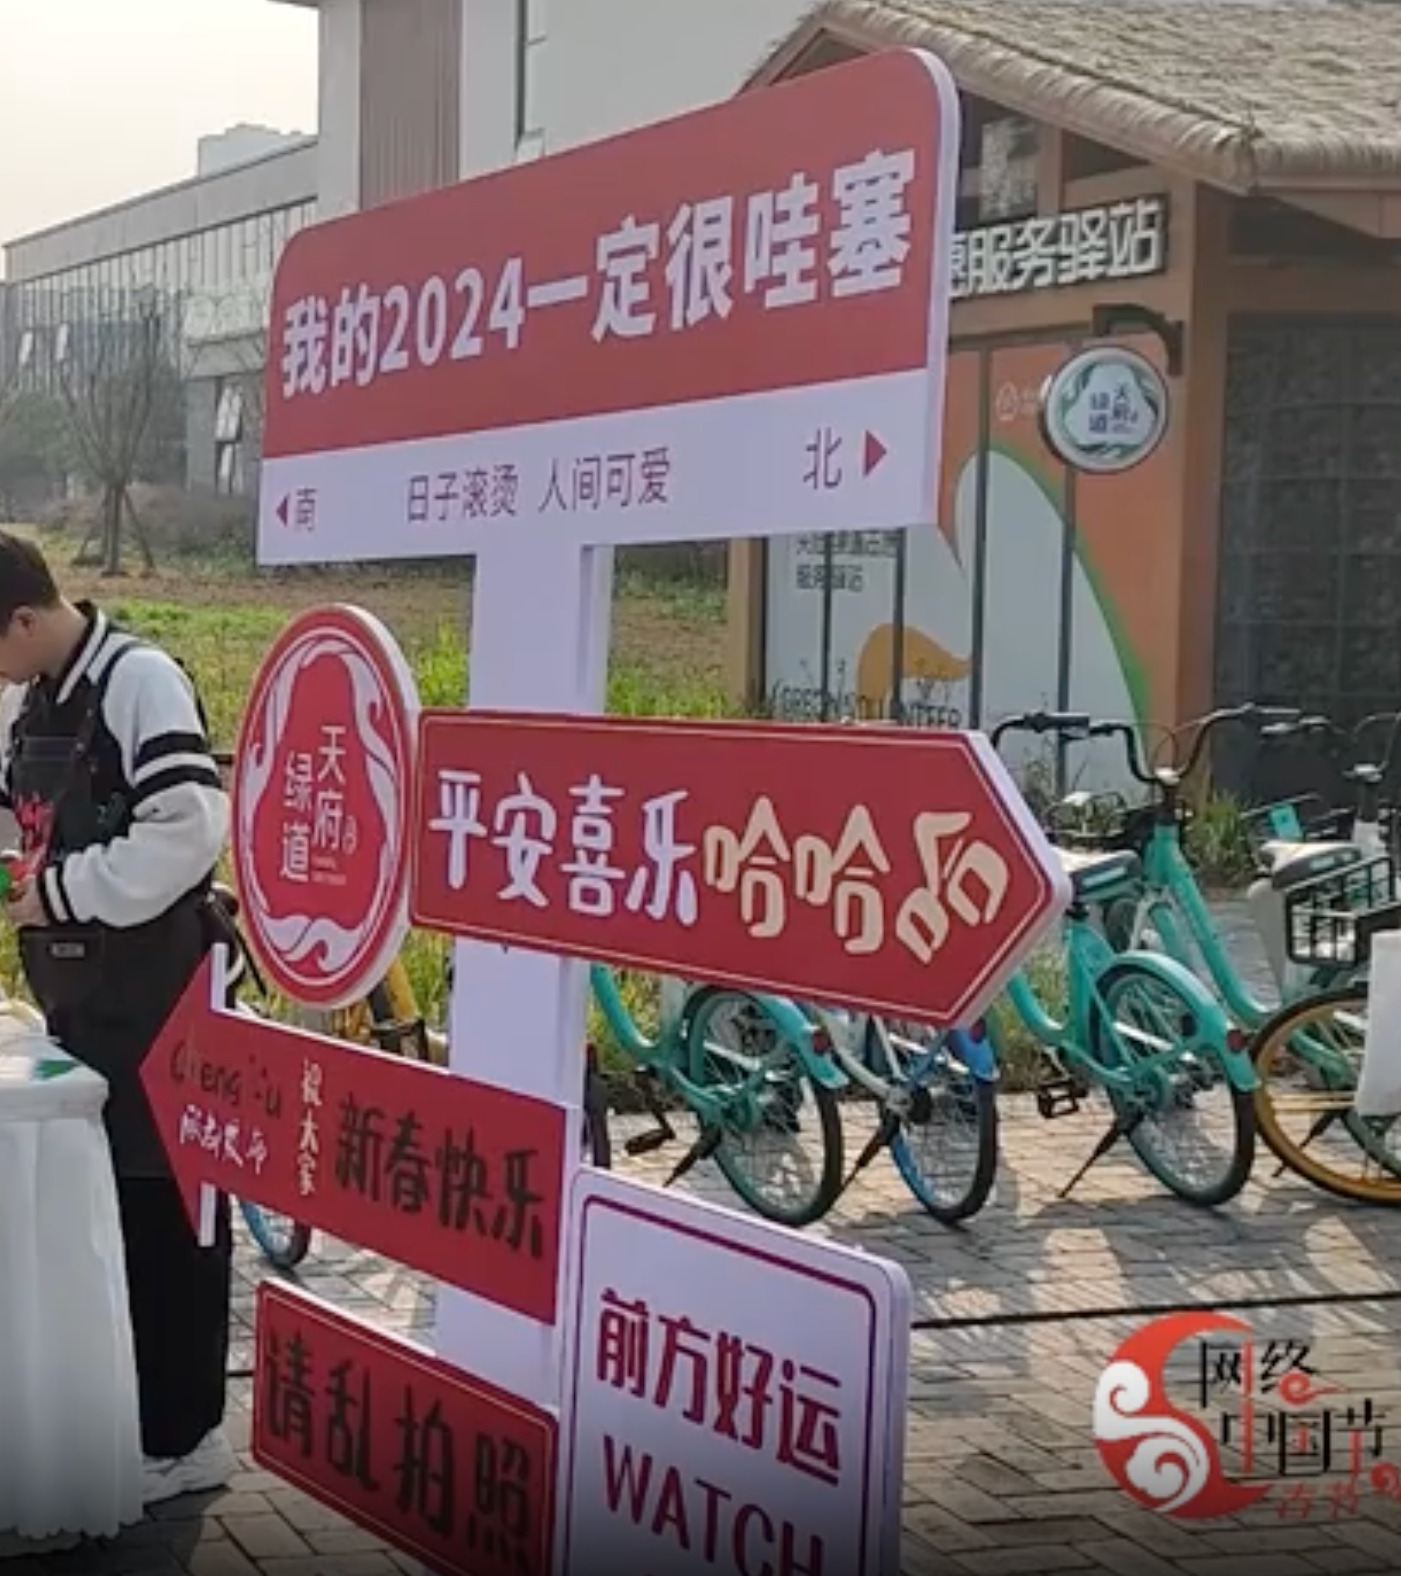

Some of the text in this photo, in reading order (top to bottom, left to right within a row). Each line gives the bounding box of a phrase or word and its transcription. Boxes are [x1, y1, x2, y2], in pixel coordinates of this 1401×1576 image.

[281, 148, 915, 398] 我的2024一定很哇塞
[407, 446, 671, 523] 日子滚烫 人间可爱
[803, 426, 843, 491] 北
[279, 750, 312, 882] 绿道
[316, 725, 347, 850] 天府
[335, 1091, 545, 1259] 新春快乐
[264, 1328, 531, 1574] 请乱拍照
[598, 1289, 841, 1487] 前方好运
[603, 1434, 823, 1576] WATCH
